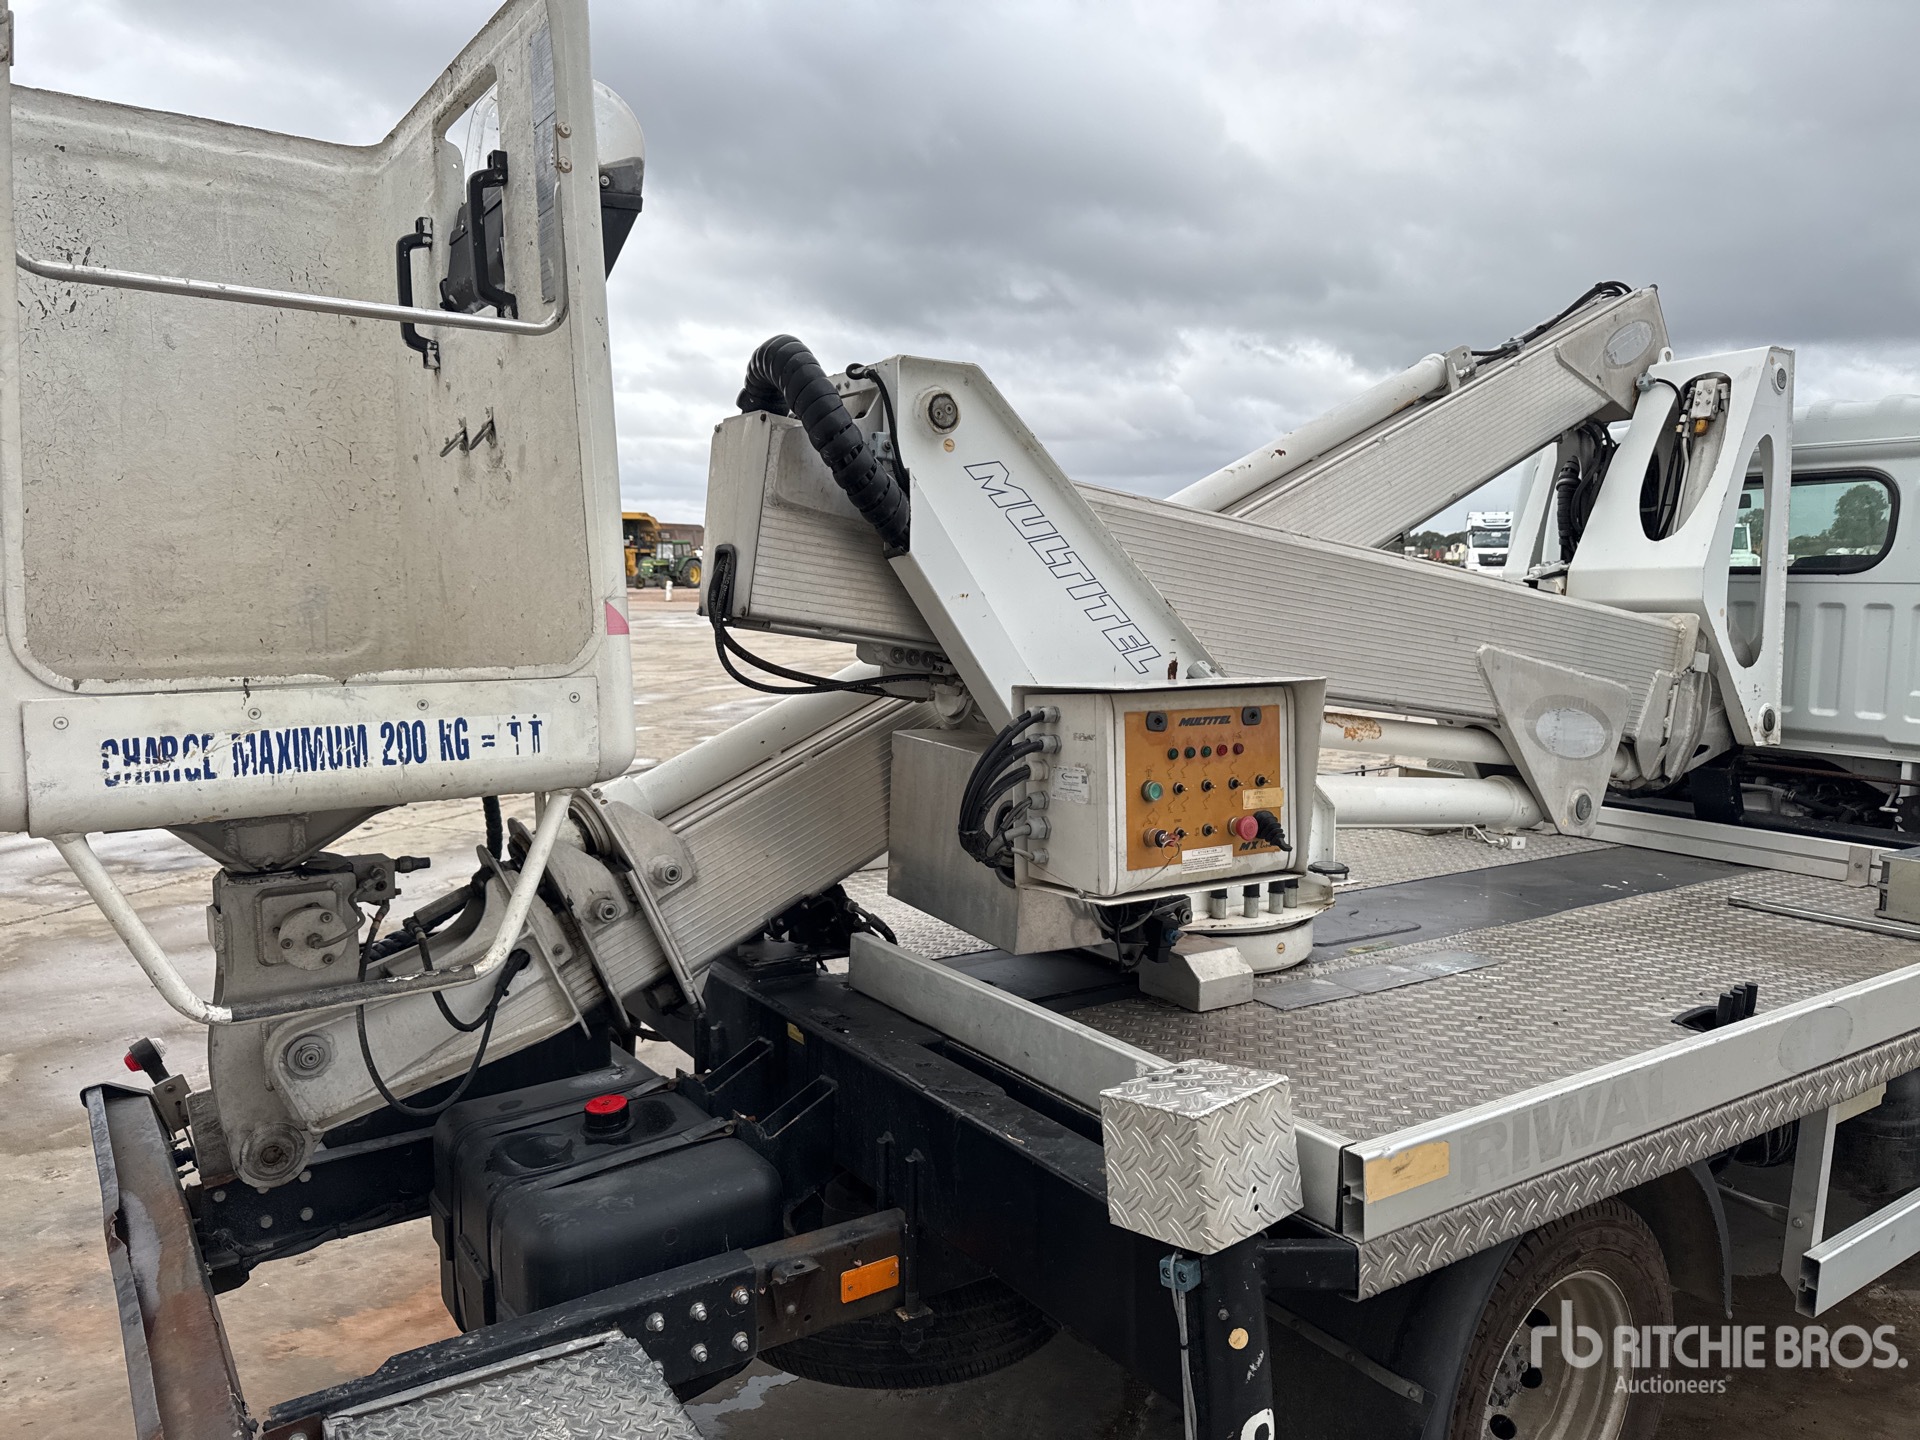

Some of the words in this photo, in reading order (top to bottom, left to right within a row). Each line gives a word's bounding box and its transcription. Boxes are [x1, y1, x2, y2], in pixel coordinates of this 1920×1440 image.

[963, 460, 1161, 674] MULTITEL
[231, 724, 369, 777] MAXIMUM
[380, 719, 428, 766] 200
[438, 717, 470, 762] KG
[1178, 714, 1232, 727] MULTITEL
[1238, 841, 1259, 851] MX
[1460, 1066, 1677, 1189] RIWAL
